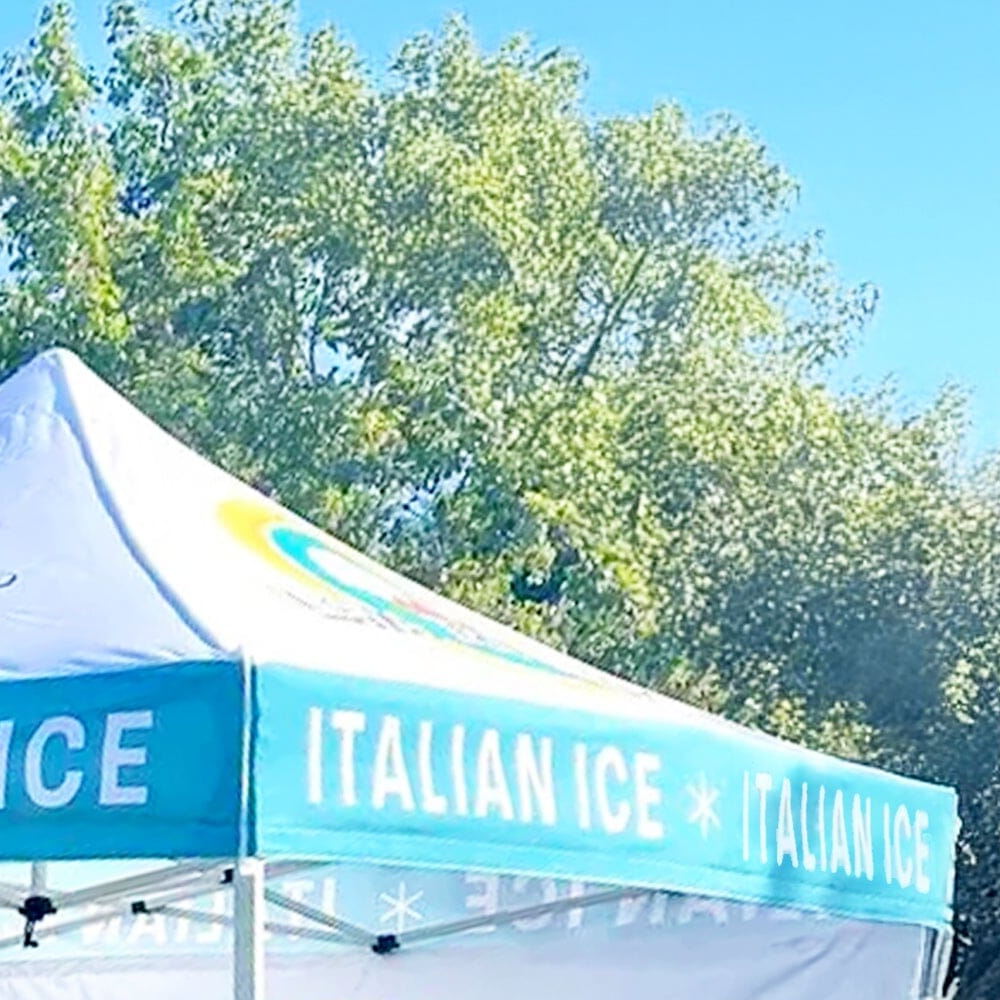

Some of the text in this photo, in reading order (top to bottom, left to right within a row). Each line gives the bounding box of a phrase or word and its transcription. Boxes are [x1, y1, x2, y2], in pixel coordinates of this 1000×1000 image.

[307, 706, 931, 893] ITALIAN ICE ITALIAN ICE
